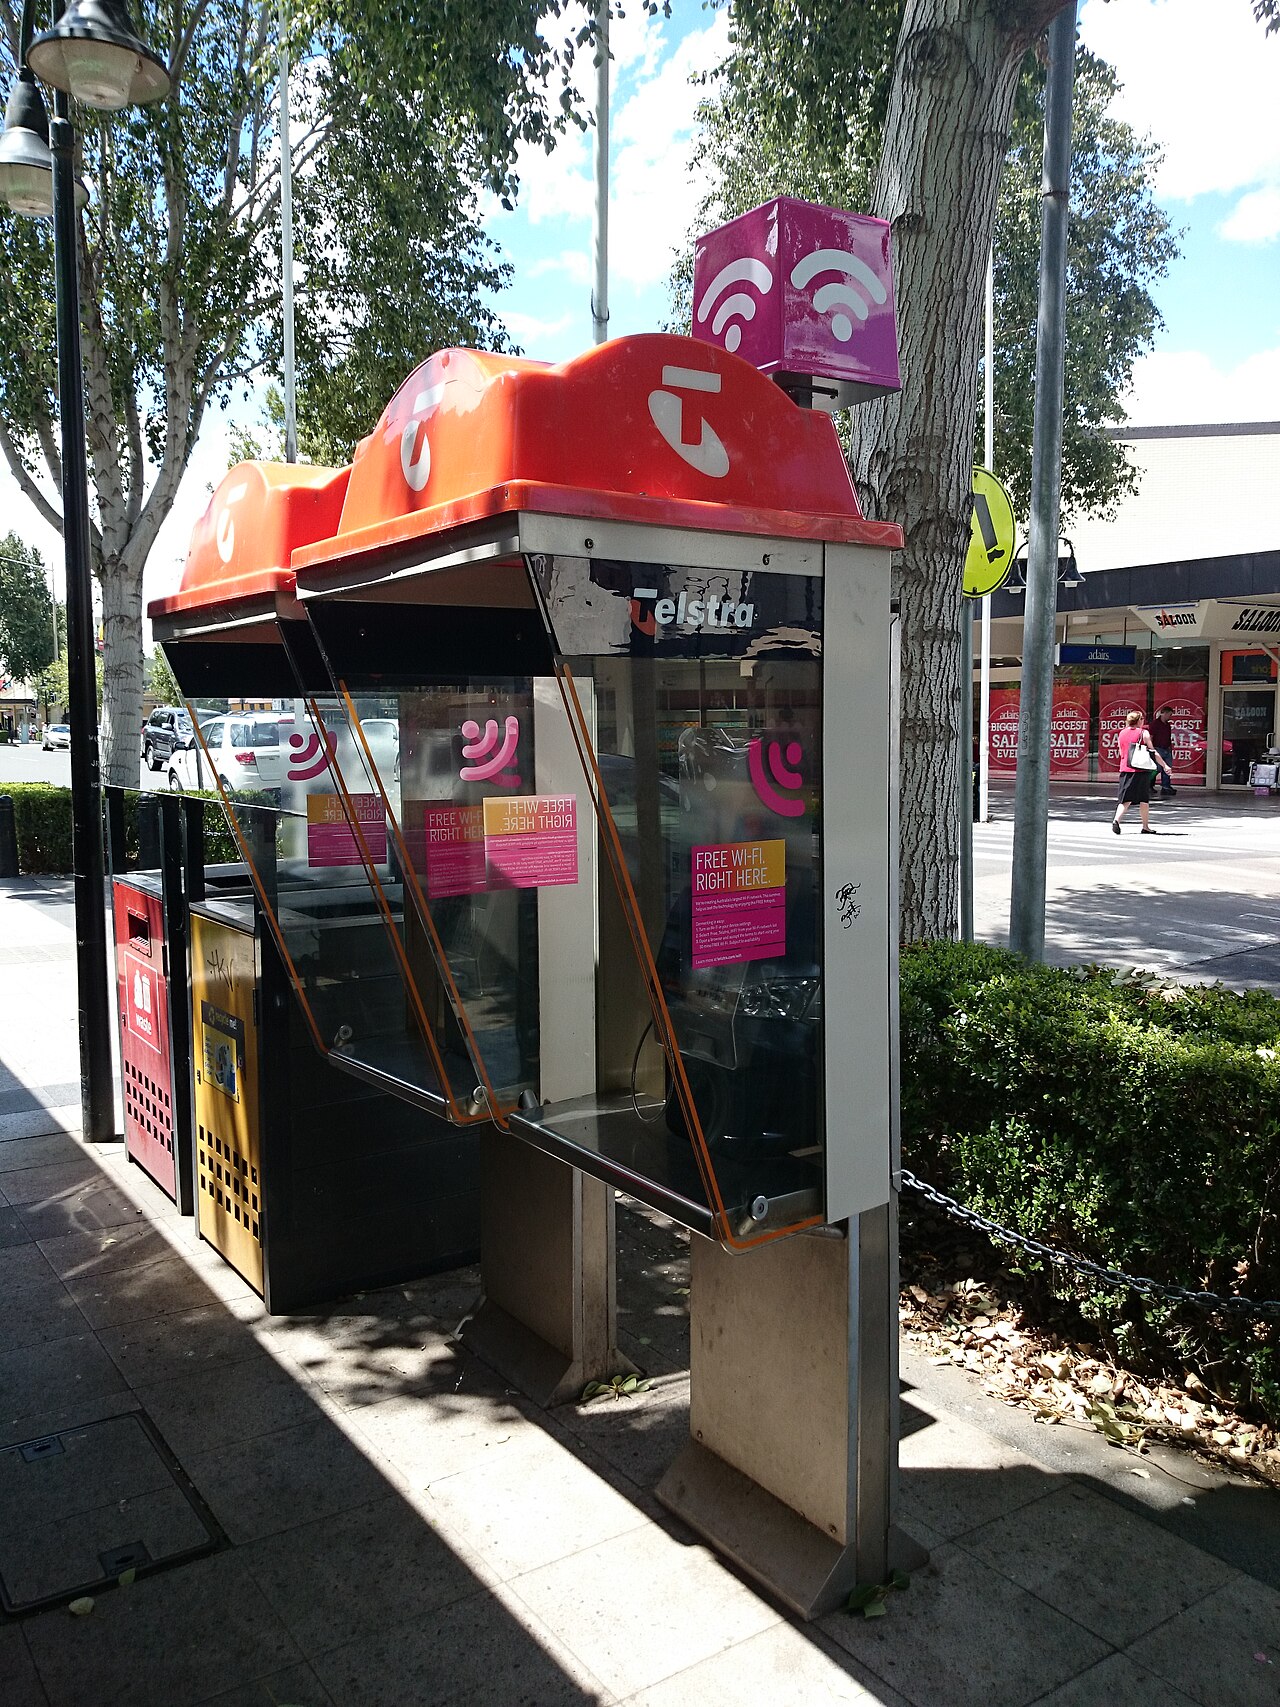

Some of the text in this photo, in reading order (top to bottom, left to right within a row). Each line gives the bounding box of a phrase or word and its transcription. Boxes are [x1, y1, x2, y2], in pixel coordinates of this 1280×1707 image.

[632, 588, 754, 629] Telstra
[1154, 613, 1197, 626] SALOON
[1088, 648, 1110, 660] adairs
[1000, 710, 1020, 719] adairs
[1056, 708, 1078, 718] adairs
[1110, 706, 1133, 716] adair
[1172, 706, 1190, 716] dairs
[1234, 707, 1267, 717] SALOON
[990, 722, 1020, 732] BIGGE
[1101, 720, 1127, 730] BIGG
[1168, 720, 1202, 730] GGEST
[992, 734, 1018, 748] SAL
[1050, 734, 1085, 748] SALE
[1102, 733, 1120, 747] SA
[1171, 734, 1199, 748] ALE
[1054, 749, 1079, 758] EVER
[1108, 750, 1120, 759] EV
[1172, 750, 1192, 760] VER
[429, 810, 482, 827] FREE WI-F
[430, 825, 483, 842] RIGHT HER
[696, 848, 765, 870] FREE WI-FI.
[696, 868, 771, 891] RIGHT HERE.
[136, 1012, 152, 1036] waste
